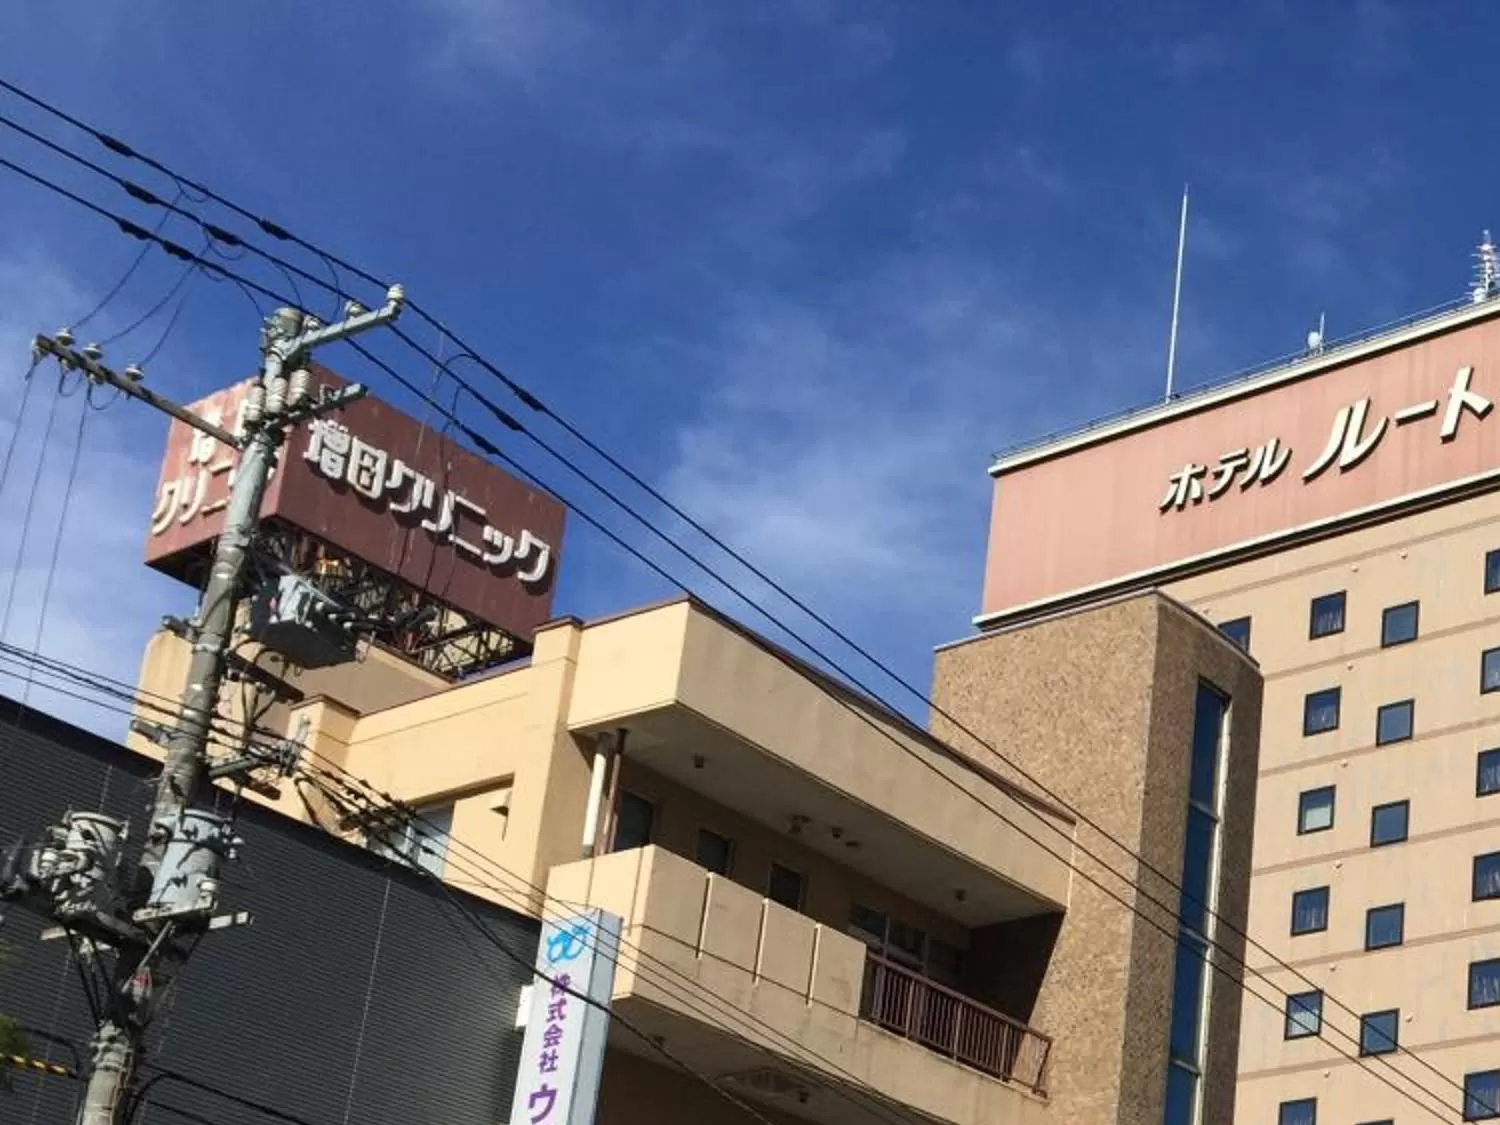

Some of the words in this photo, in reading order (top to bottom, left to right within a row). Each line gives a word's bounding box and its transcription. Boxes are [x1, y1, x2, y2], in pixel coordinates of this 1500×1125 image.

[1159, 437, 1292, 513] ホテル
[539, 973, 571, 1074] 株式会社
